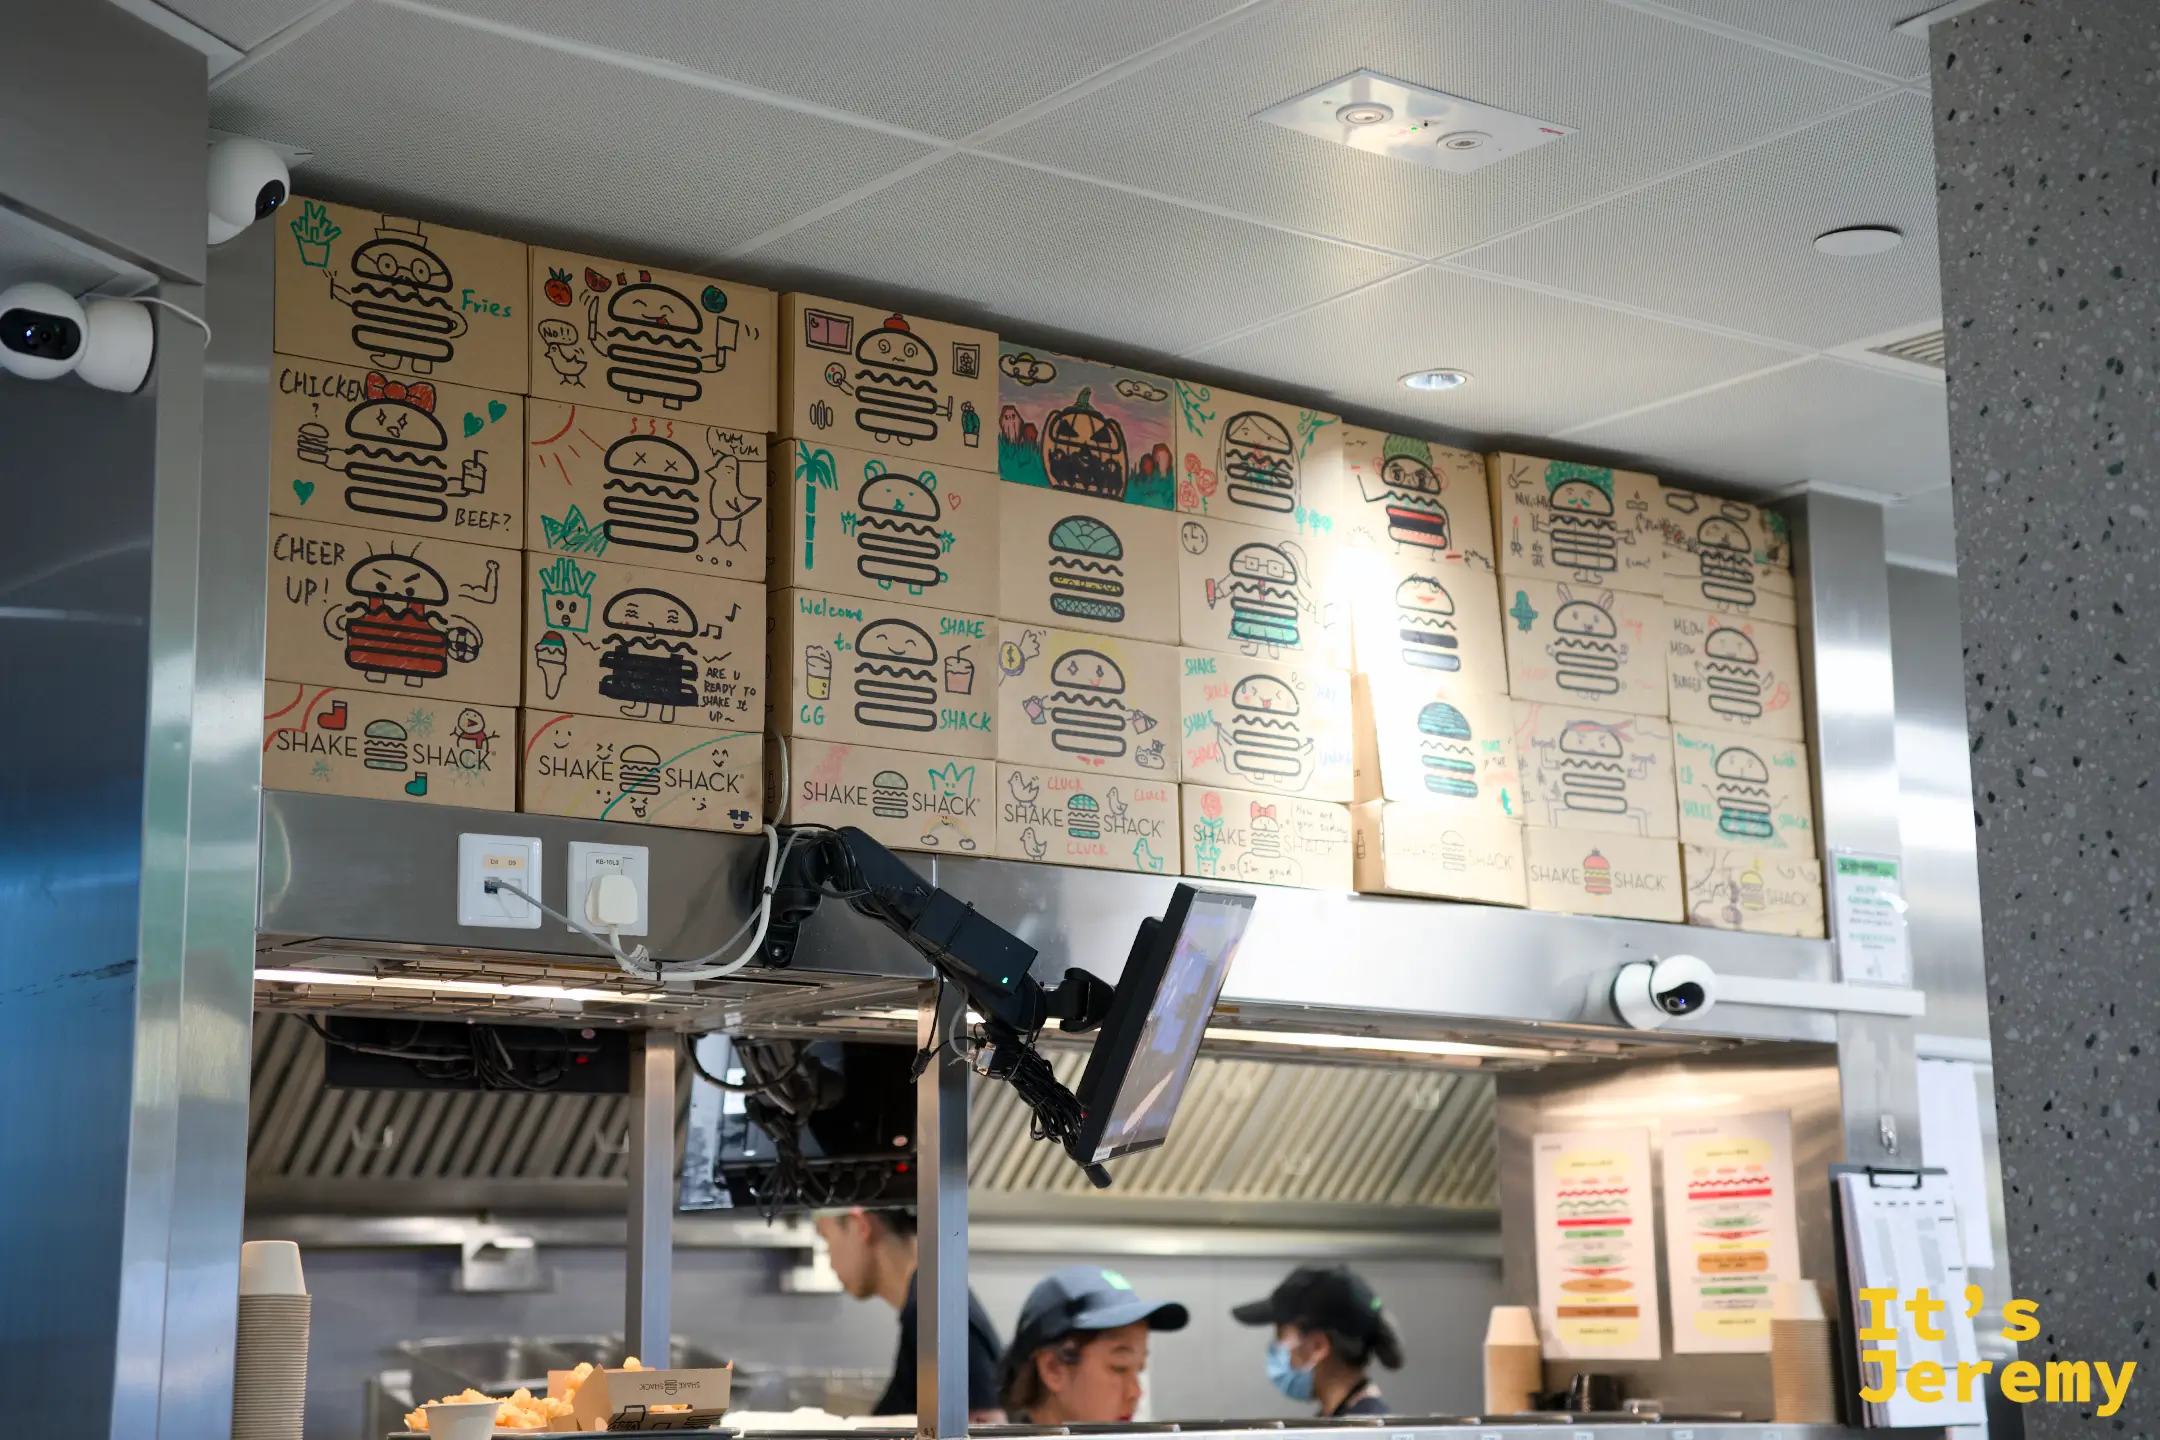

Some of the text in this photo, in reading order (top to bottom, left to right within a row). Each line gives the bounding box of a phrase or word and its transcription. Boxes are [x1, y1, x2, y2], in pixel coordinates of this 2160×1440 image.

[461, 290, 512, 317] Fries
[543, 326, 572, 341] No!!
[279, 368, 366, 402] CHICKEN
[715, 429, 743, 445] YUM
[730, 444, 759, 456] YUM
[454, 508, 512, 531] BEEF?
[273, 533, 346, 566] CHEER
[286, 575, 329, 607] UP!
[800, 597, 863, 622] Welcome
[939, 617, 986, 639] SHAKE
[834, 632, 852, 652] to
[706, 667, 741, 680] ARE U
[1184, 657, 1217, 676] SHAKE
[704, 680, 757, 697] READY TO
[700, 695, 730, 708] SHAKE
[939, 709, 992, 733] SHACK
[276, 730, 358, 758] SHAKE
[538, 755, 615, 782] SHAKE
[802, 781, 868, 806] SHAKE
[1047, 776, 1084, 792] CLUCK
[1004, 804, 1064, 828] SHAKE
[1193, 824, 1247, 847] SHAKE
[1530, 864, 1581, 886] SHAKE
[679, 1381, 701, 1390] SHAKE
